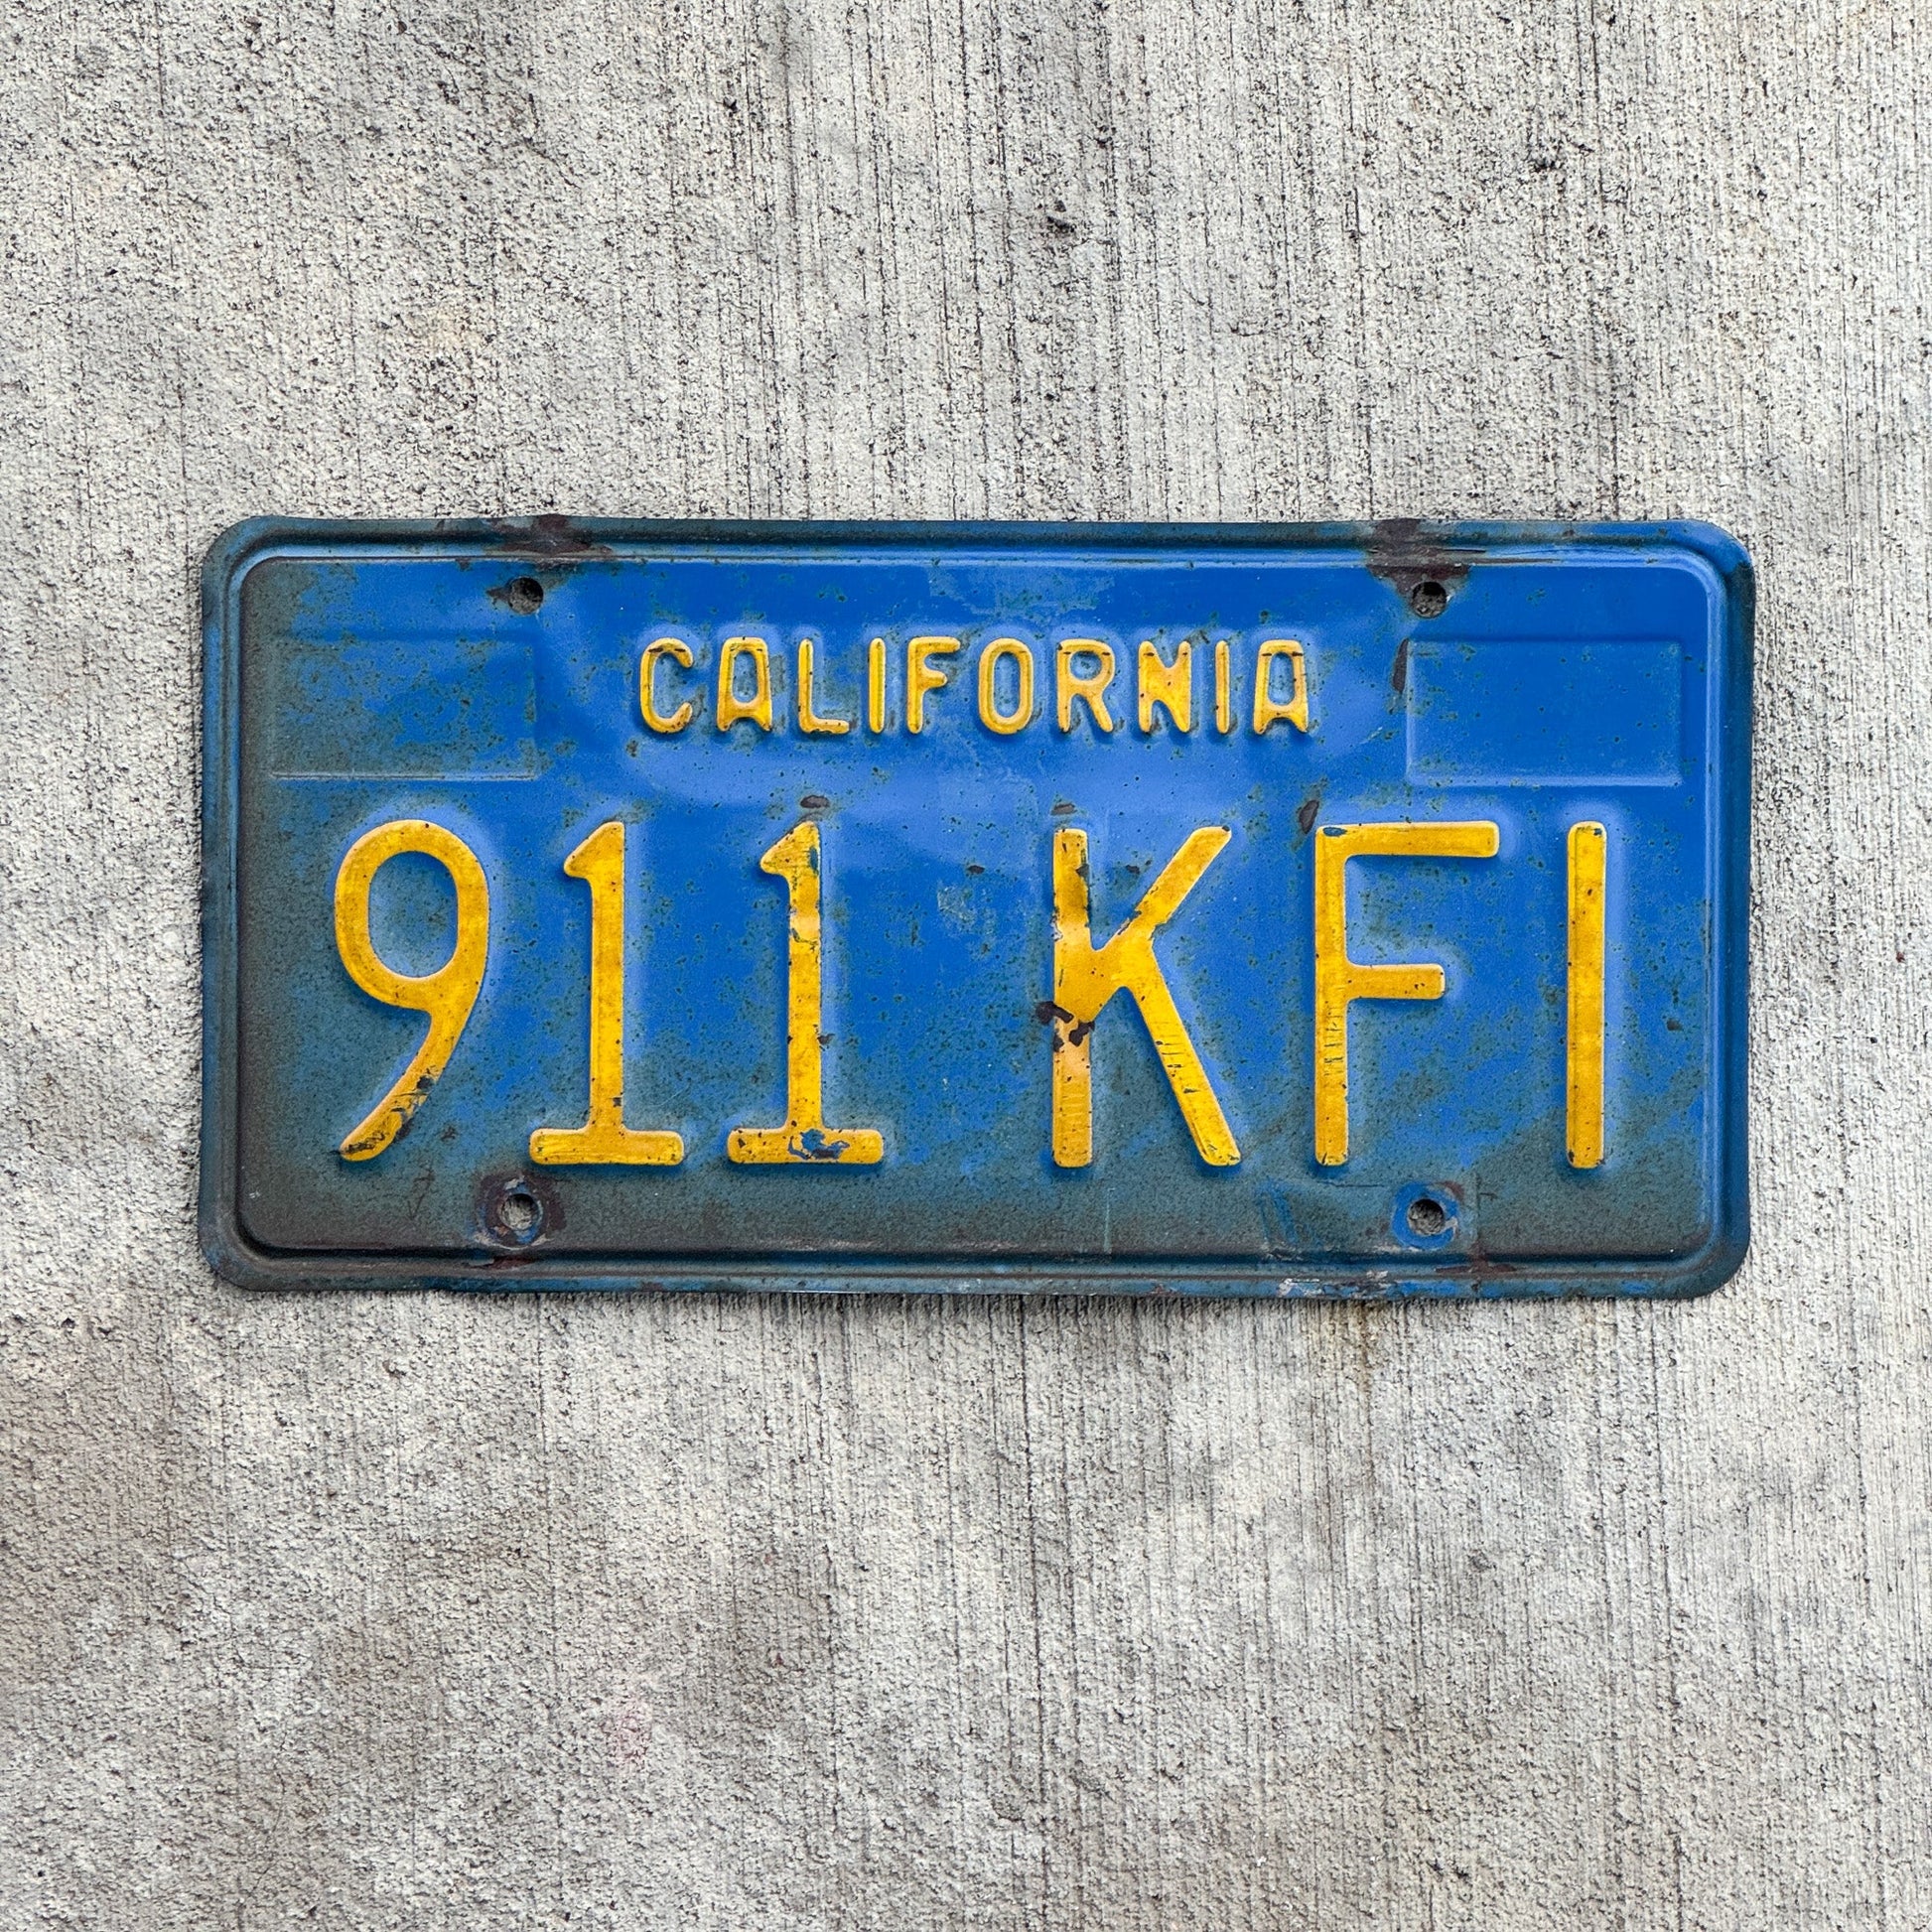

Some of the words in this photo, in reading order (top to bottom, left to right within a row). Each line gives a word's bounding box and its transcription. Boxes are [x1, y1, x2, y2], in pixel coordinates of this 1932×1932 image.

[638, 636, 1310, 735] CALIFORNIA
[334, 820, 885, 1166] 911
[1051, 820, 1607, 1169] KFI
